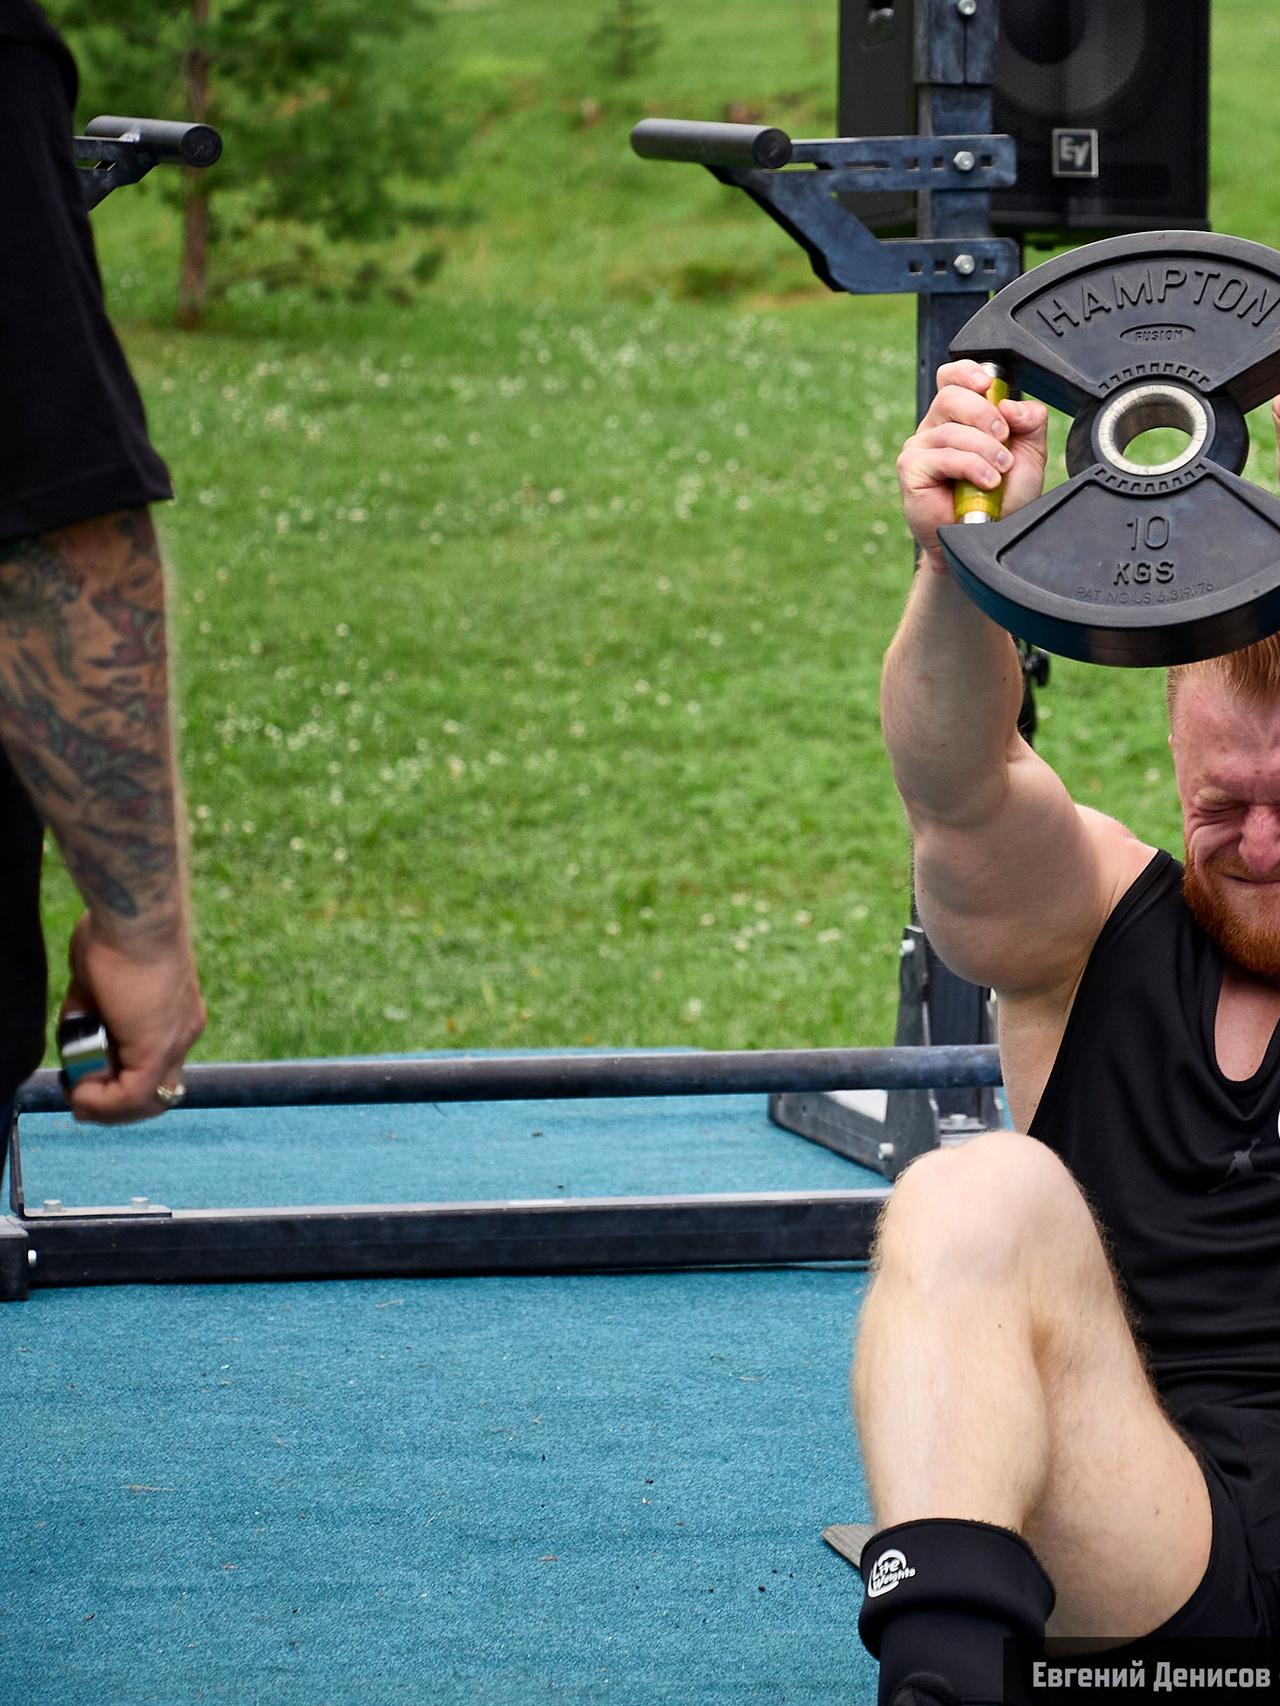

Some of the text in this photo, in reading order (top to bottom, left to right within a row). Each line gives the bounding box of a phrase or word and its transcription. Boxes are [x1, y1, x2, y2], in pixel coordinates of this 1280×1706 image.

[1134, 329, 1183, 342] FUSION
[1126, 515, 1171, 551] 10
[1113, 561, 1175, 586] KGS
